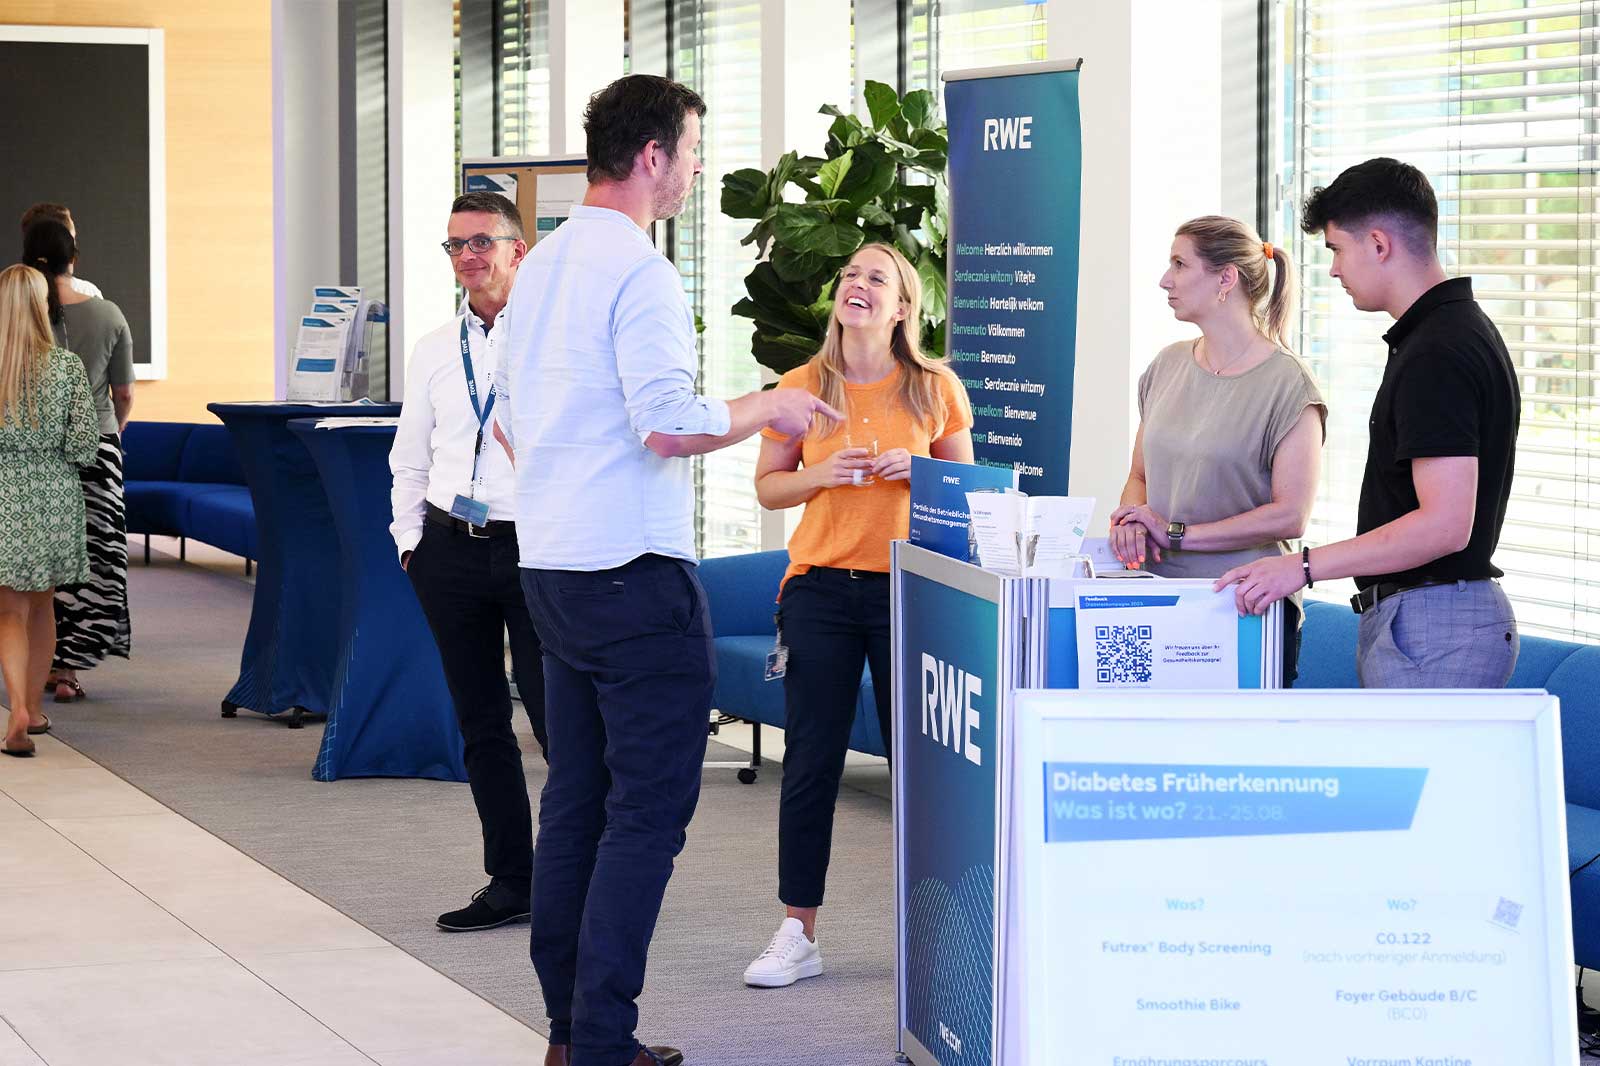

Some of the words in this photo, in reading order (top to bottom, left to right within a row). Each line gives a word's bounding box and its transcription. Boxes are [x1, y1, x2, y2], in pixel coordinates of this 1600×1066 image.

[983, 116, 1033, 152] RWE
[956, 243, 984, 256] Welcome
[985, 242, 1011, 256] Herzlich
[1012, 242, 1053, 256] willkommen
[954, 270, 989, 282] Serdecznie
[990, 270, 1014, 285] witamy
[1014, 270, 1036, 285] Vitejte
[953, 296, 988, 309] Bienvenido
[990, 297, 1017, 312] Hartelijk
[1018, 298, 1044, 311] welkom
[952, 322, 986, 335] Benvenuto
[987, 323, 1025, 338] Välkommen
[951, 349, 980, 362] Welcome
[981, 350, 1016, 364] Benvenuto
[985, 377, 1019, 392] Serdecznie
[1020, 379, 1045, 397] witamy
[977, 404, 1004, 418] welkom
[1004, 405, 1037, 421] Bienvenue
[987, 431, 1023, 447] Bienvenido
[1013, 461, 1043, 477] Welcome
[943, 475, 960, 485] RWE
[921, 651, 982, 767] RWE
[1052, 770, 1158, 794] Diabetes
[1162, 771, 1340, 798] Früherkennung
[1053, 800, 1103, 821] Was
[1108, 799, 1138, 821] ist
[1141, 800, 1186, 822] wo?
[1165, 897, 1205, 911] Was?
[1386, 898, 1417, 912] Wo?
[1158, 941, 1194, 956] Body
[1198, 940, 1272, 957] Screening
[1136, 997, 1206, 1011] Smoothie
[1210, 997, 1241, 1011] Bike
[1335, 989, 1375, 1005] Foyer
[1449, 989, 1478, 1003] B/C
